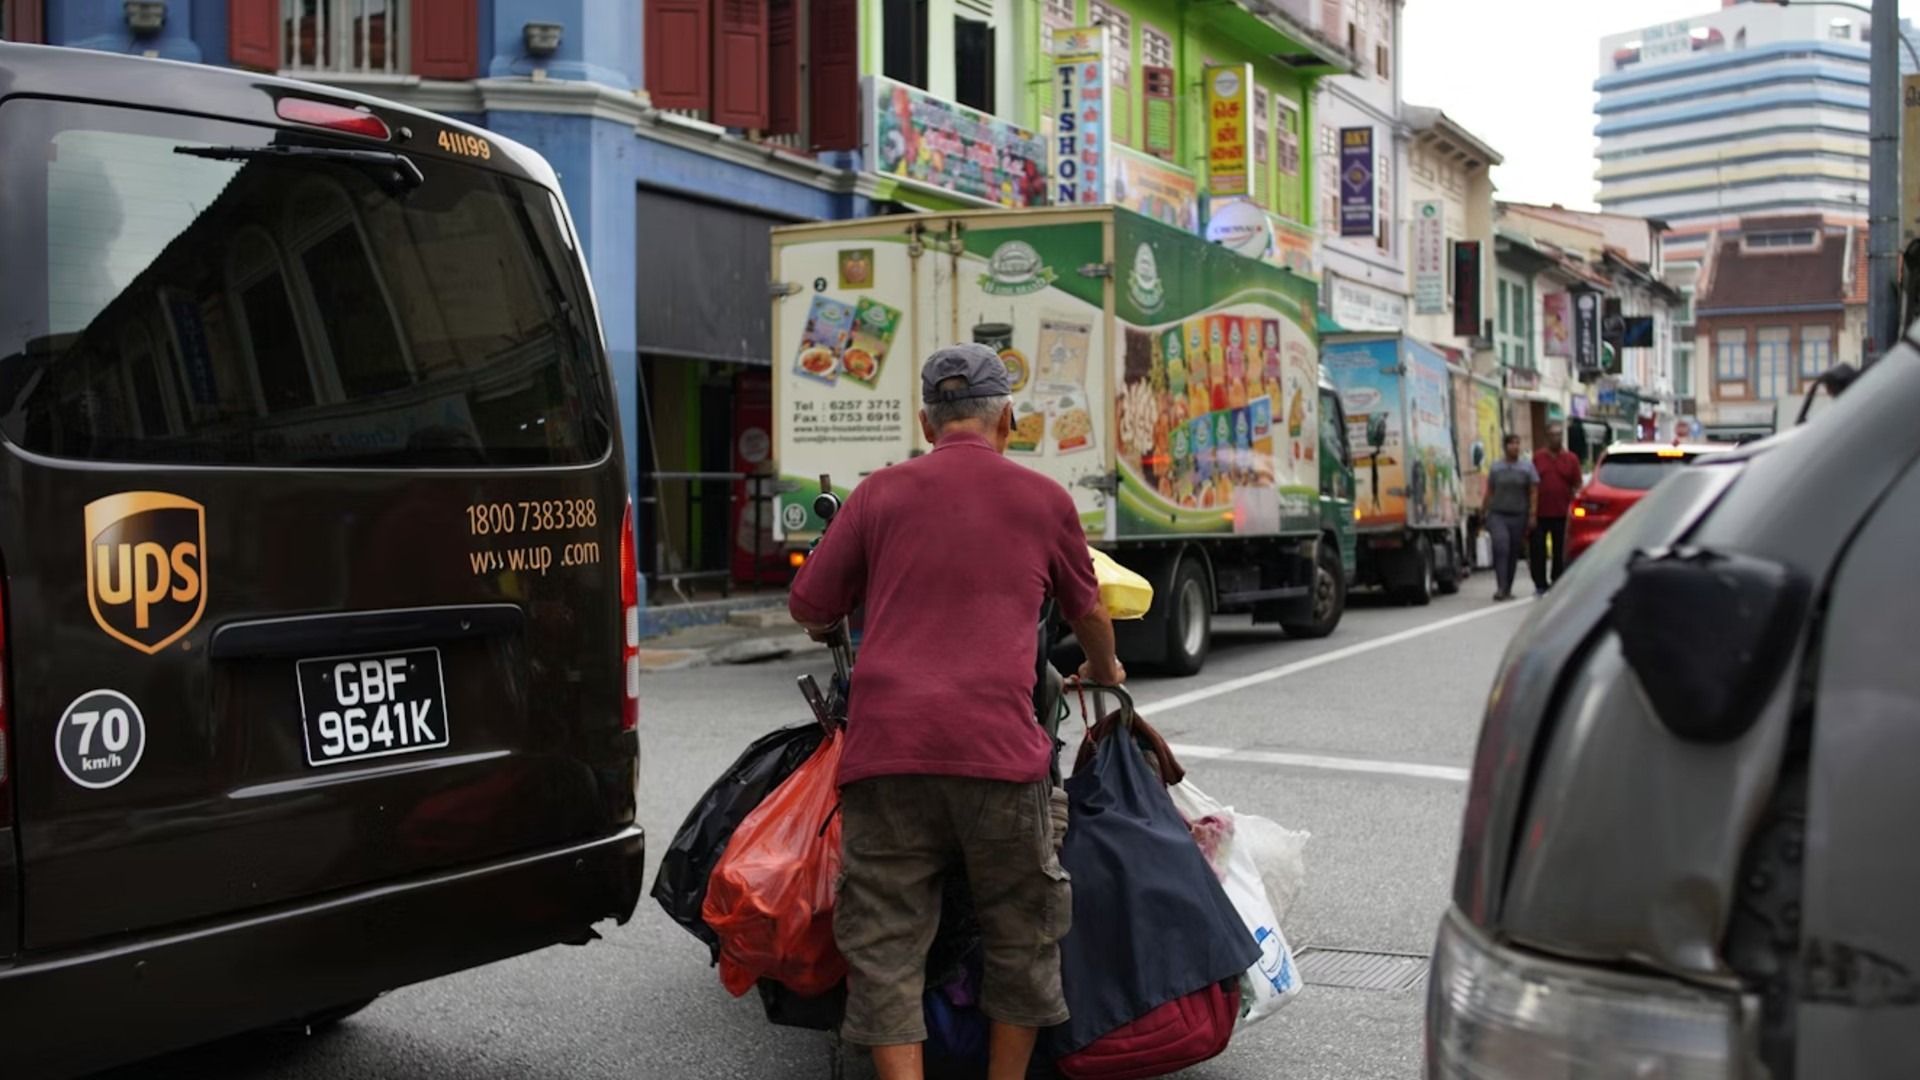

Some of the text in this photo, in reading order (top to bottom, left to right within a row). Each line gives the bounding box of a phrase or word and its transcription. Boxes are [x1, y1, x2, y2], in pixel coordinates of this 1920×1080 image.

[438, 130, 491, 160] 411199
[1059, 66, 1076, 203] TISHON
[793, 401, 814, 411] Tel
[829, 400, 862, 410] 6257
[867, 399, 900, 409] 3712
[793, 413, 817, 423] Fax
[466, 498, 598, 535] 1800 7383388
[97, 541, 200, 629] ups
[334, 657, 407, 706] GBF
[71, 707, 130, 755] 70
[318, 698, 436, 756] 9641K
[82, 753, 122, 771] km/h
